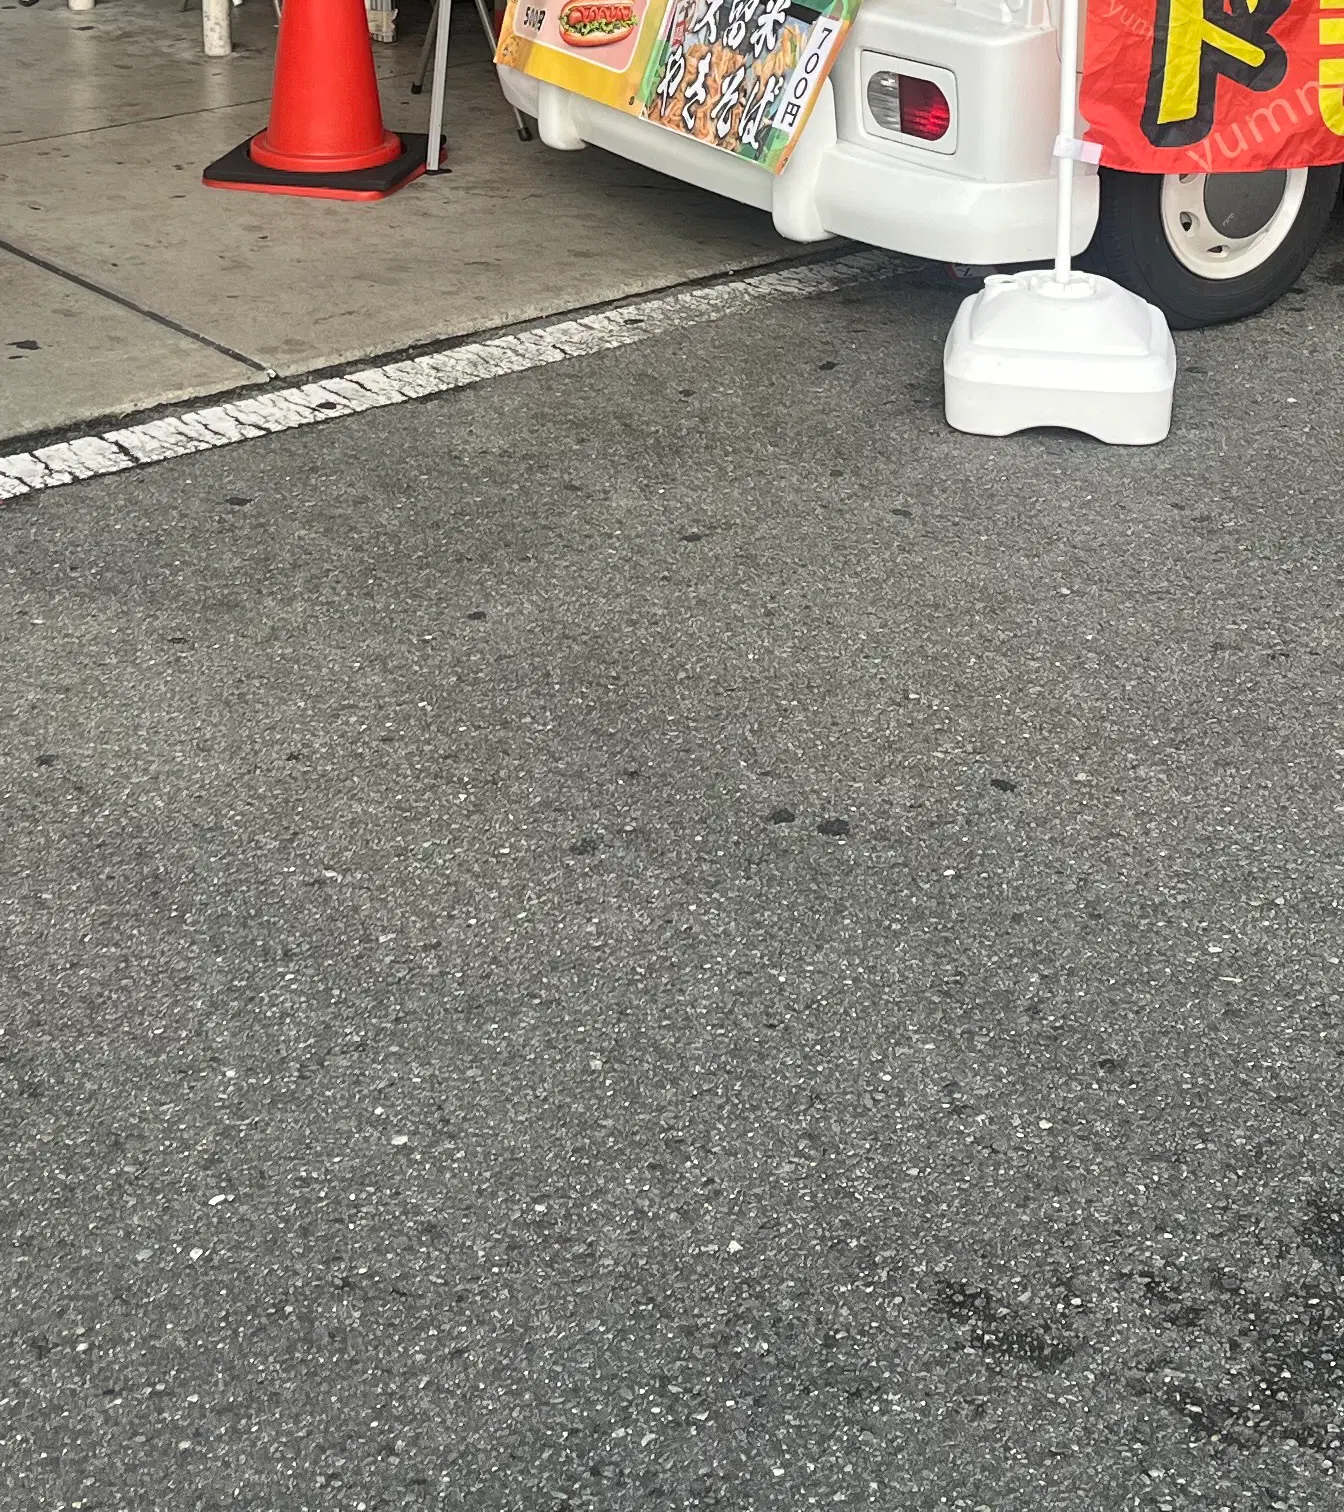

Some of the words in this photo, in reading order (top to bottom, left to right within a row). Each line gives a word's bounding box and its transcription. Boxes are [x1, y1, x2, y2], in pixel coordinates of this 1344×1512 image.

[656, 44, 784, 149] やきそば
[781, 26, 834, 129] 700円
